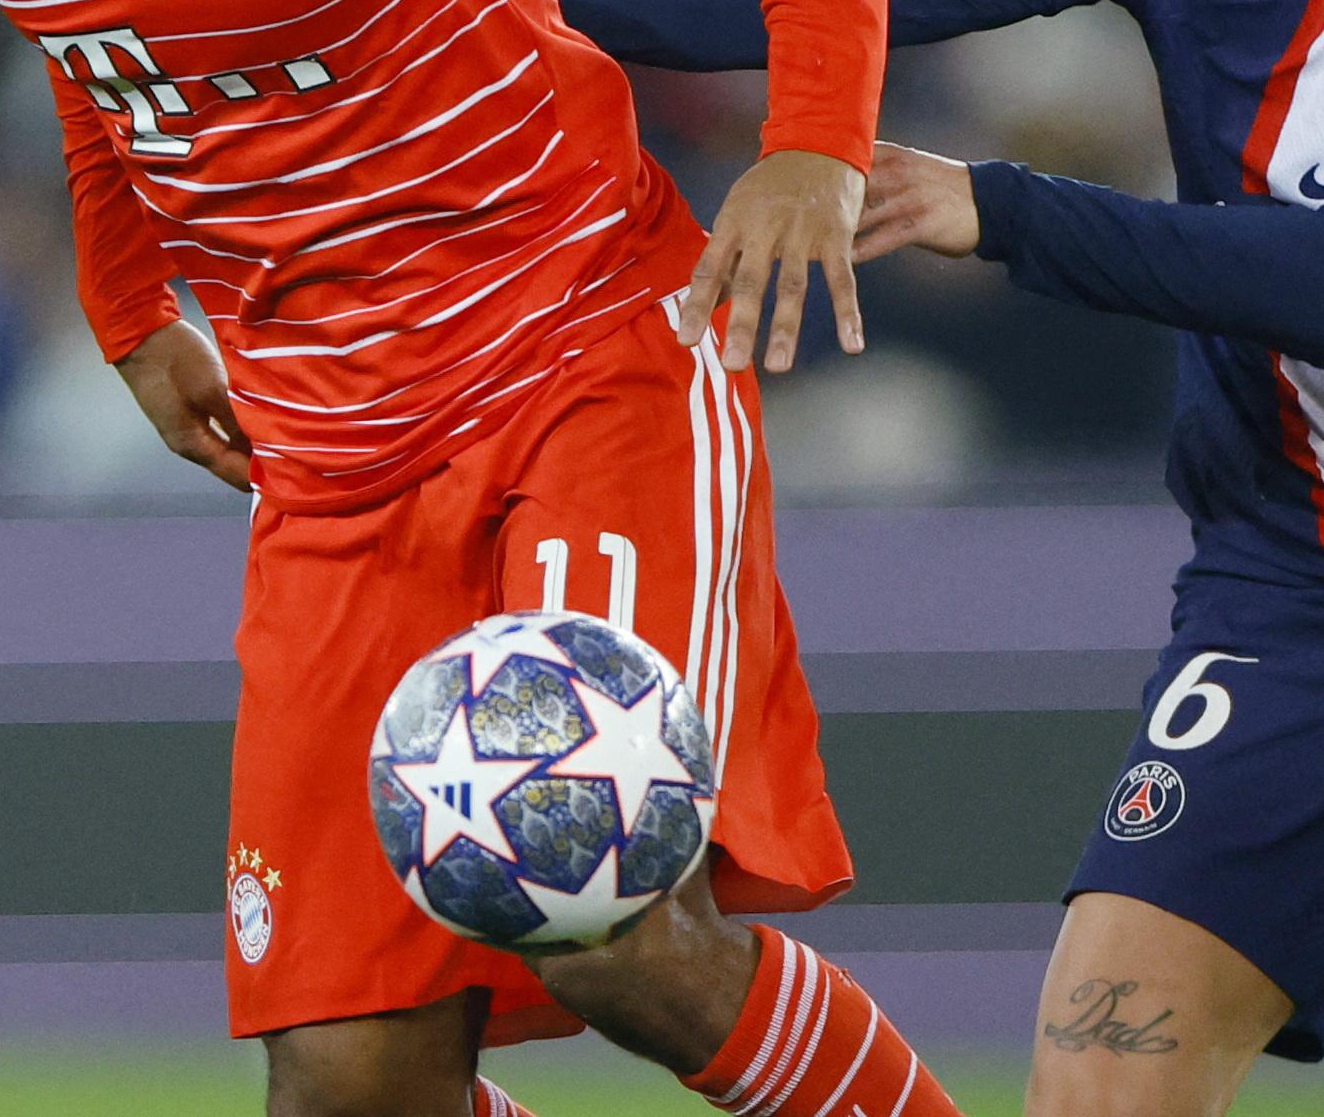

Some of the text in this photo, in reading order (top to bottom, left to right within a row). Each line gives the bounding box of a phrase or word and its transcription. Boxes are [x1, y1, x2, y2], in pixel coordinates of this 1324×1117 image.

[535, 531, 637, 633] 11
[1147, 651, 1260, 751] 6
[1129, 765, 1177, 790] PARIS
